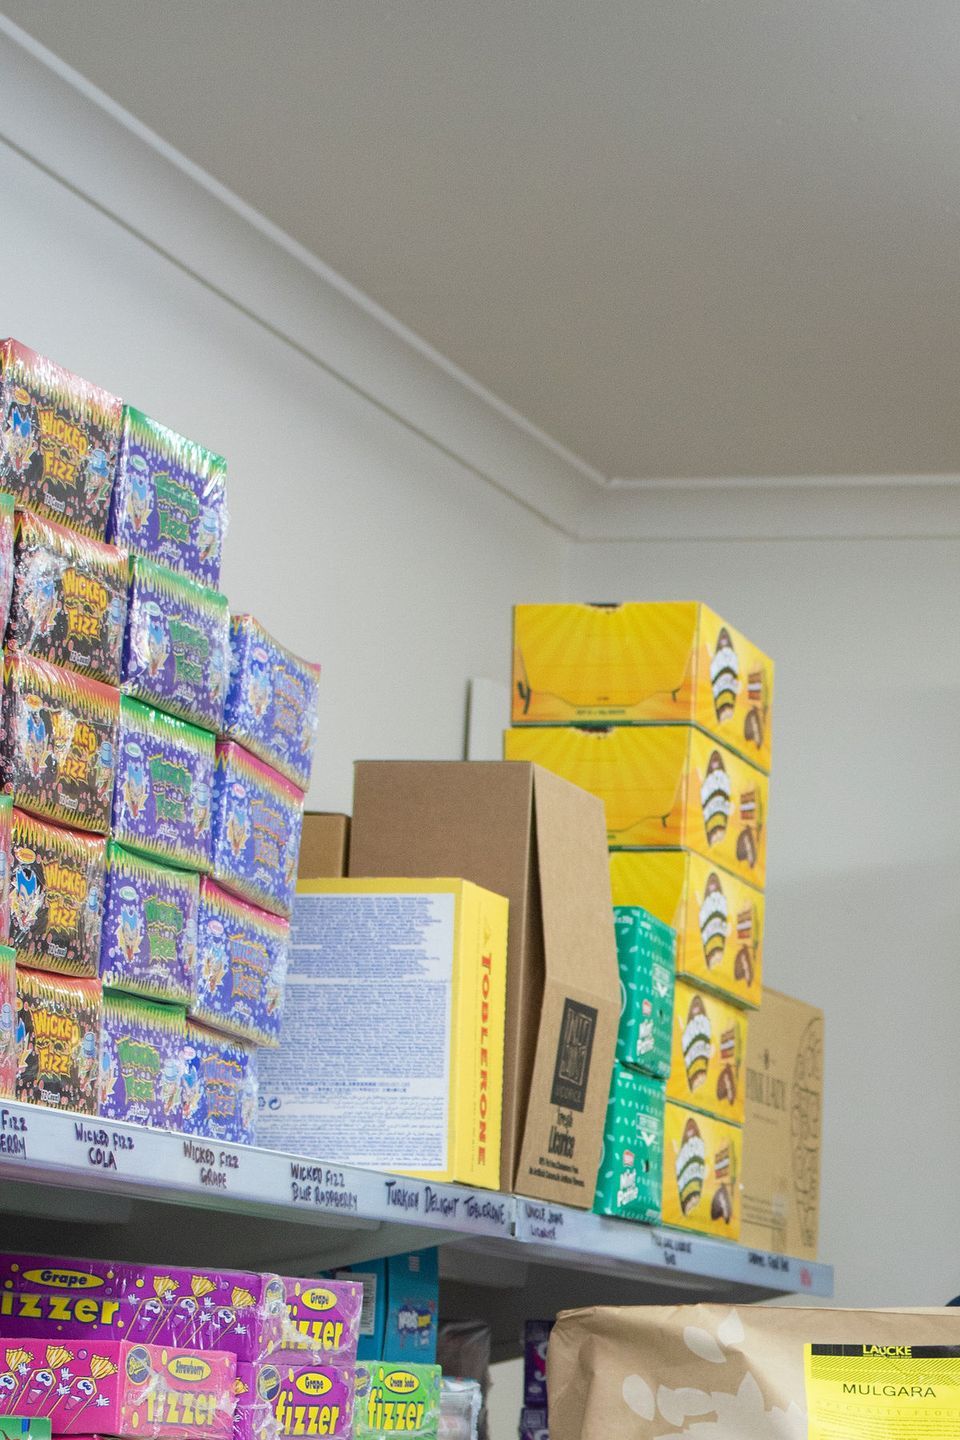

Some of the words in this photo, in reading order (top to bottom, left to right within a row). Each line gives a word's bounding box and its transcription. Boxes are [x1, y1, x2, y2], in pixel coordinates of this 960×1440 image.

[39, 409, 88, 454] WICKED
[45, 451, 74, 482] FIZZ
[62, 568, 107, 610] WICKED
[69, 609, 99, 635] FIZZ
[44, 862, 87, 898] WICKED
[34, 1011, 79, 1043] WICKED
[39, 1050, 70, 1074] FIZZ
[477, 952, 493, 1167] TOBLERONE
[74, 1122, 110, 1148] WICKED
[88, 1147, 118, 1170] COLA
[183, 1141, 216, 1167] WICKED
[290, 1162, 323, 1184] WICKED
[40, 1270, 88, 1288] Grape
[309, 1291, 331, 1307] Grape
[862, 1344, 912, 1356] LAUCKE
[174, 1360, 206, 1380] Strawberry
[304, 1376, 325, 1392] Grape
[842, 1383, 937, 1399] MULGARA
[275, 1390, 340, 1436] fizzer
[367, 1386, 425, 1431] fizzer
